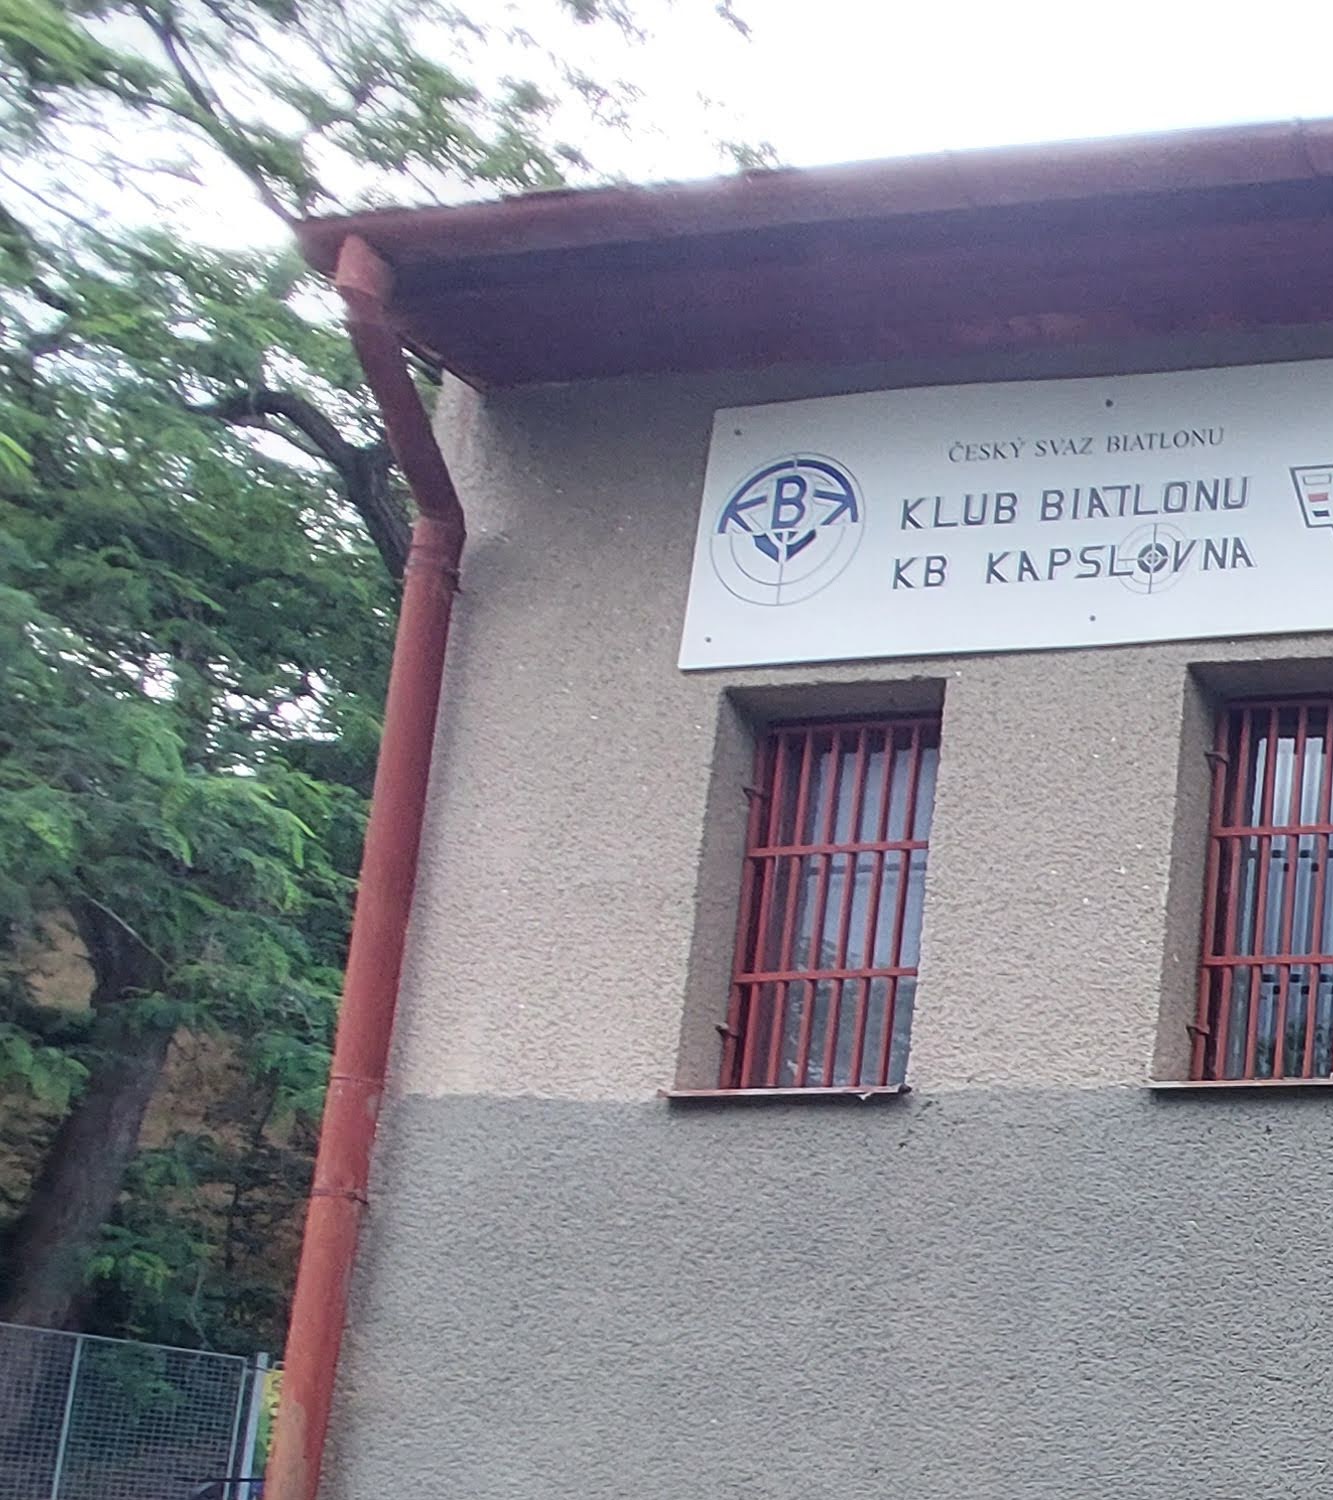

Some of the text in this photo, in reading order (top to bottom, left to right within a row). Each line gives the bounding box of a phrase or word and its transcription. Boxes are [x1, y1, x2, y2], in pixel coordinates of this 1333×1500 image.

[948, 427, 1226, 463] ČESKÝ SVAZ BIATLONU
[900, 475, 1251, 530] KLUB BIATLONU
[892, 536, 1257, 590] KB KAPSLOVNA
